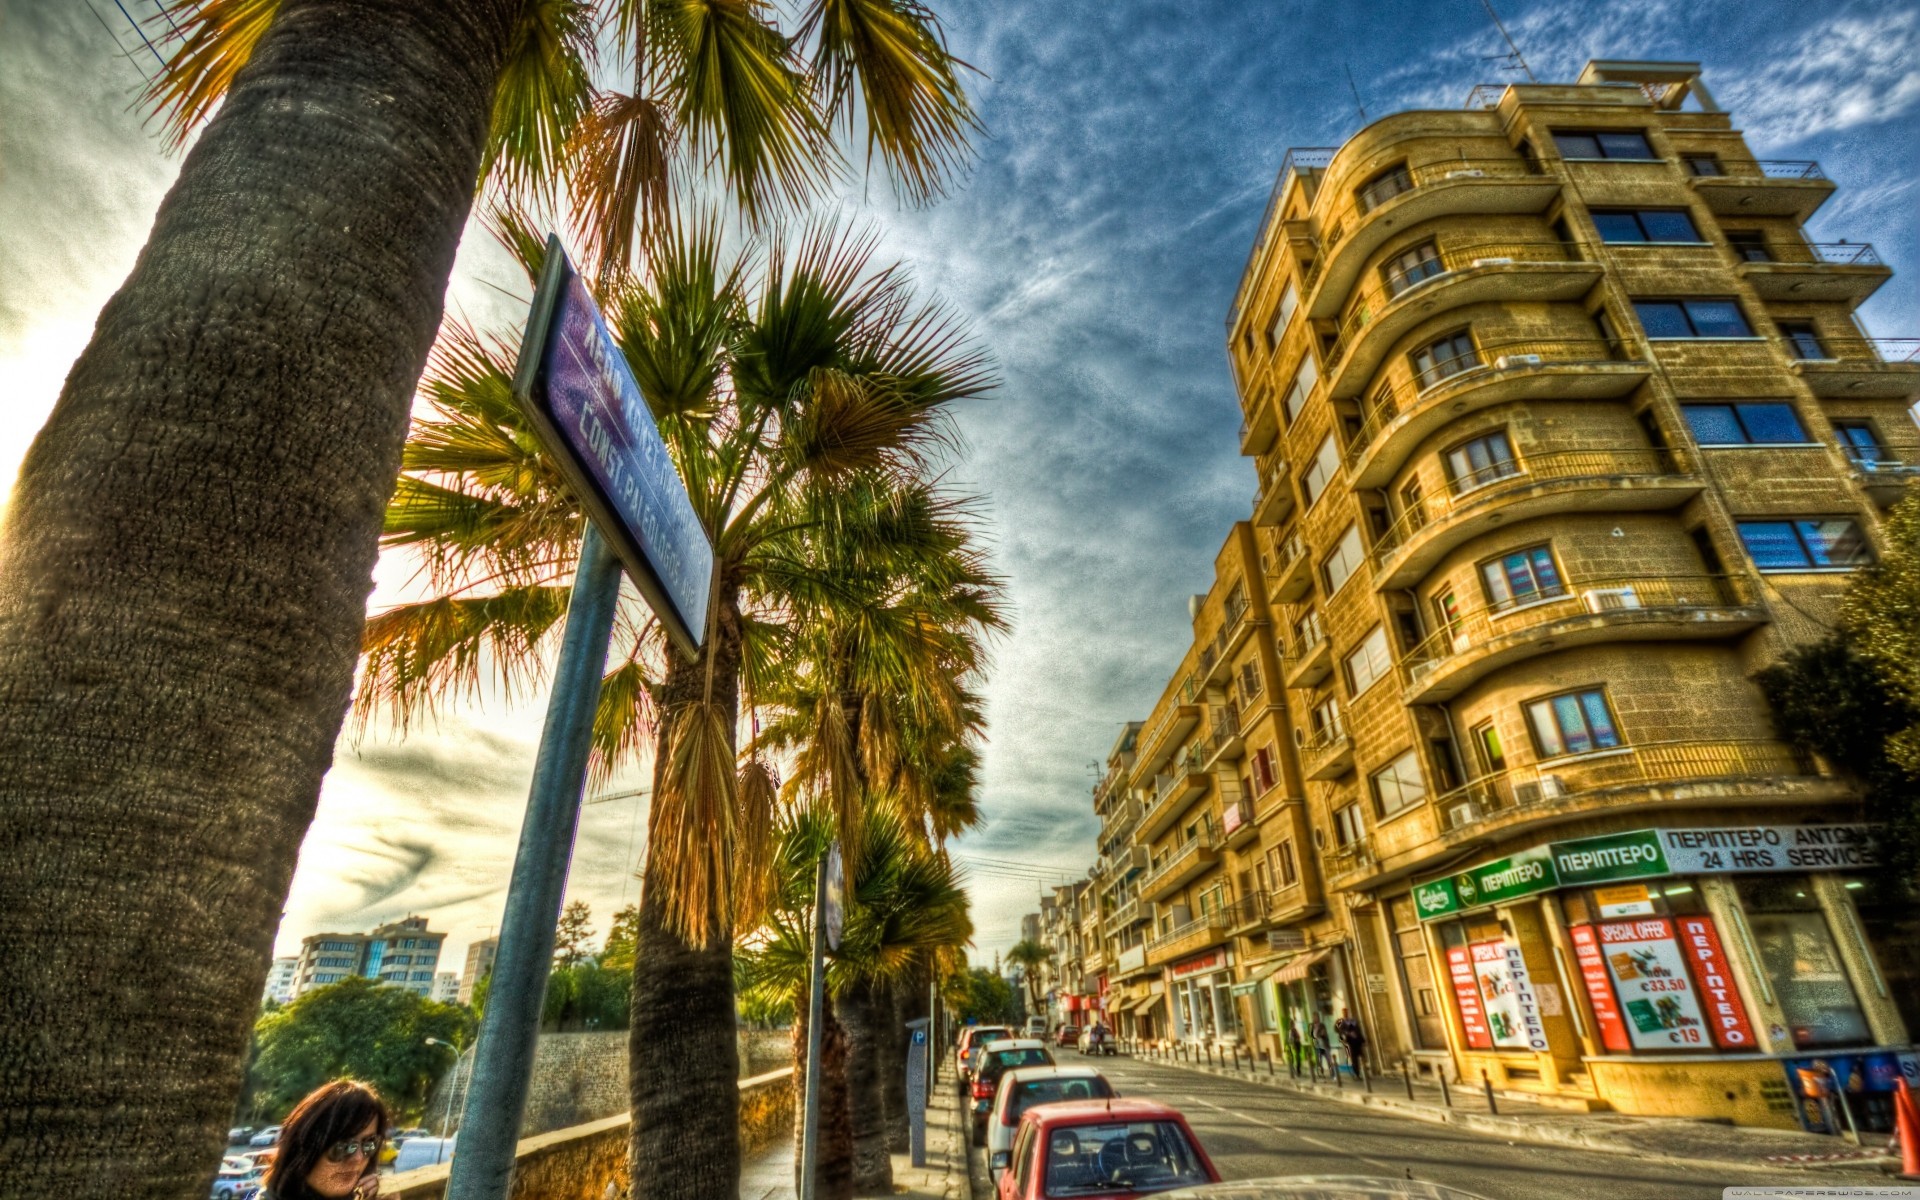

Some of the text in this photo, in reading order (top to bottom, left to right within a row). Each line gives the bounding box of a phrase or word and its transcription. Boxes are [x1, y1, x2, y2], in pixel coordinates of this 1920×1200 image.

[1667, 829, 1780, 848] ΠΕΡΙΠΤΕΡΟ
[1559, 844, 1657, 872] ΠΕΡΙΠΤΕΡΟ
[1701, 848, 1874, 868] 24 HRS SERVICE
[1482, 862, 1543, 892] ΠΕΡΙΠΤΕΡΟ
[1602, 923, 1638, 942] SPECIAL
[1636, 920, 1668, 940] OFFER
[1640, 978, 1687, 992] €33.50
[1687, 922, 1745, 1043] ΠΕΡΙΠΤΕΡΟ
[1506, 949, 1546, 1049] ΠΕΡΙΠΤΕΡΟ
[916, 1031, 924, 1043] P
[1669, 1028, 1700, 1043] €19
